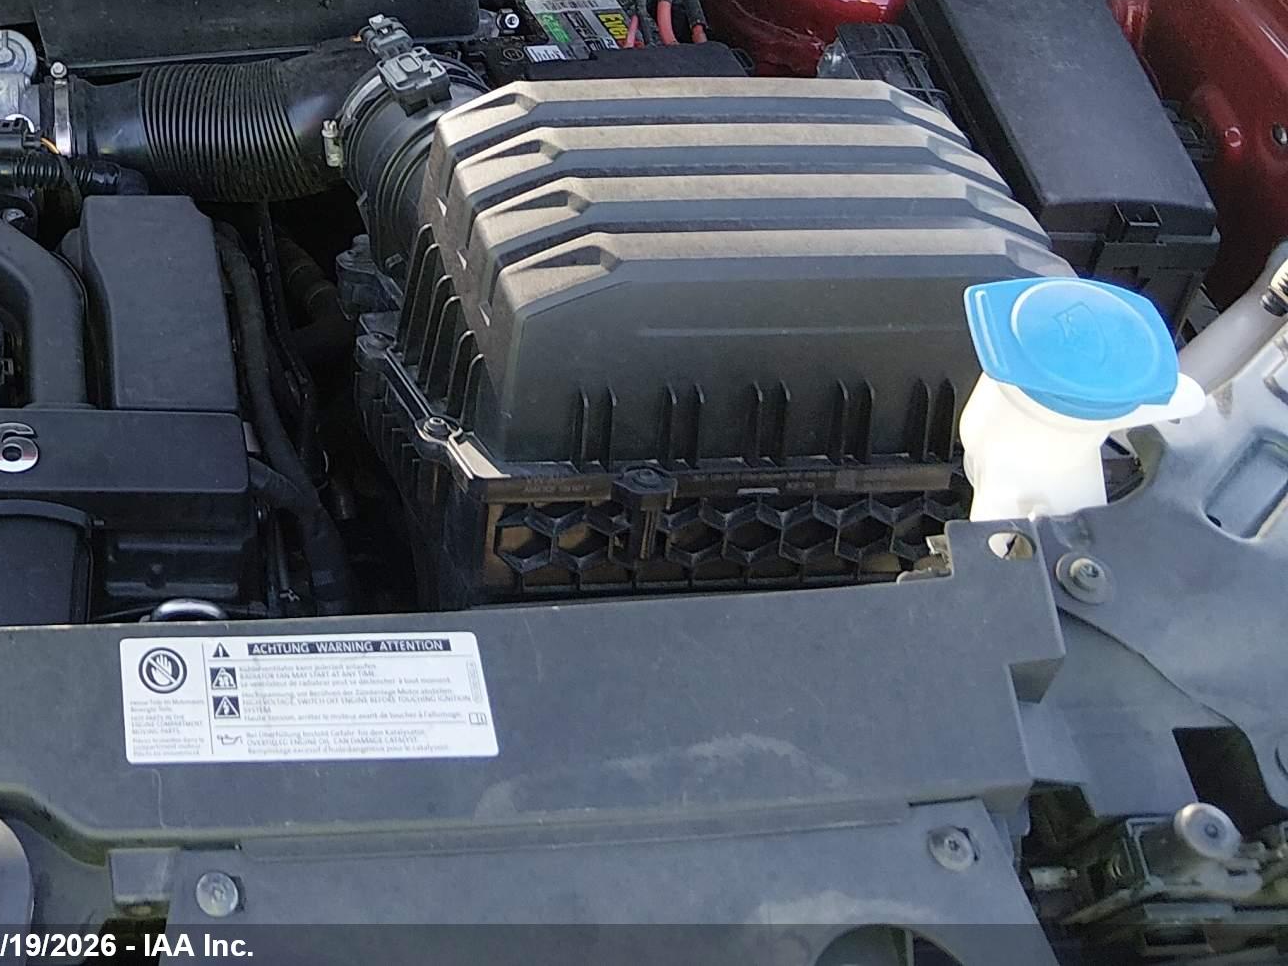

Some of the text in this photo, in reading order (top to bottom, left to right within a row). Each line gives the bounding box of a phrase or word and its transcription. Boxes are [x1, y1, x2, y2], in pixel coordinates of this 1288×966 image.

[252, 640, 443, 654] ACHTUNG WARNING ATTENTION
